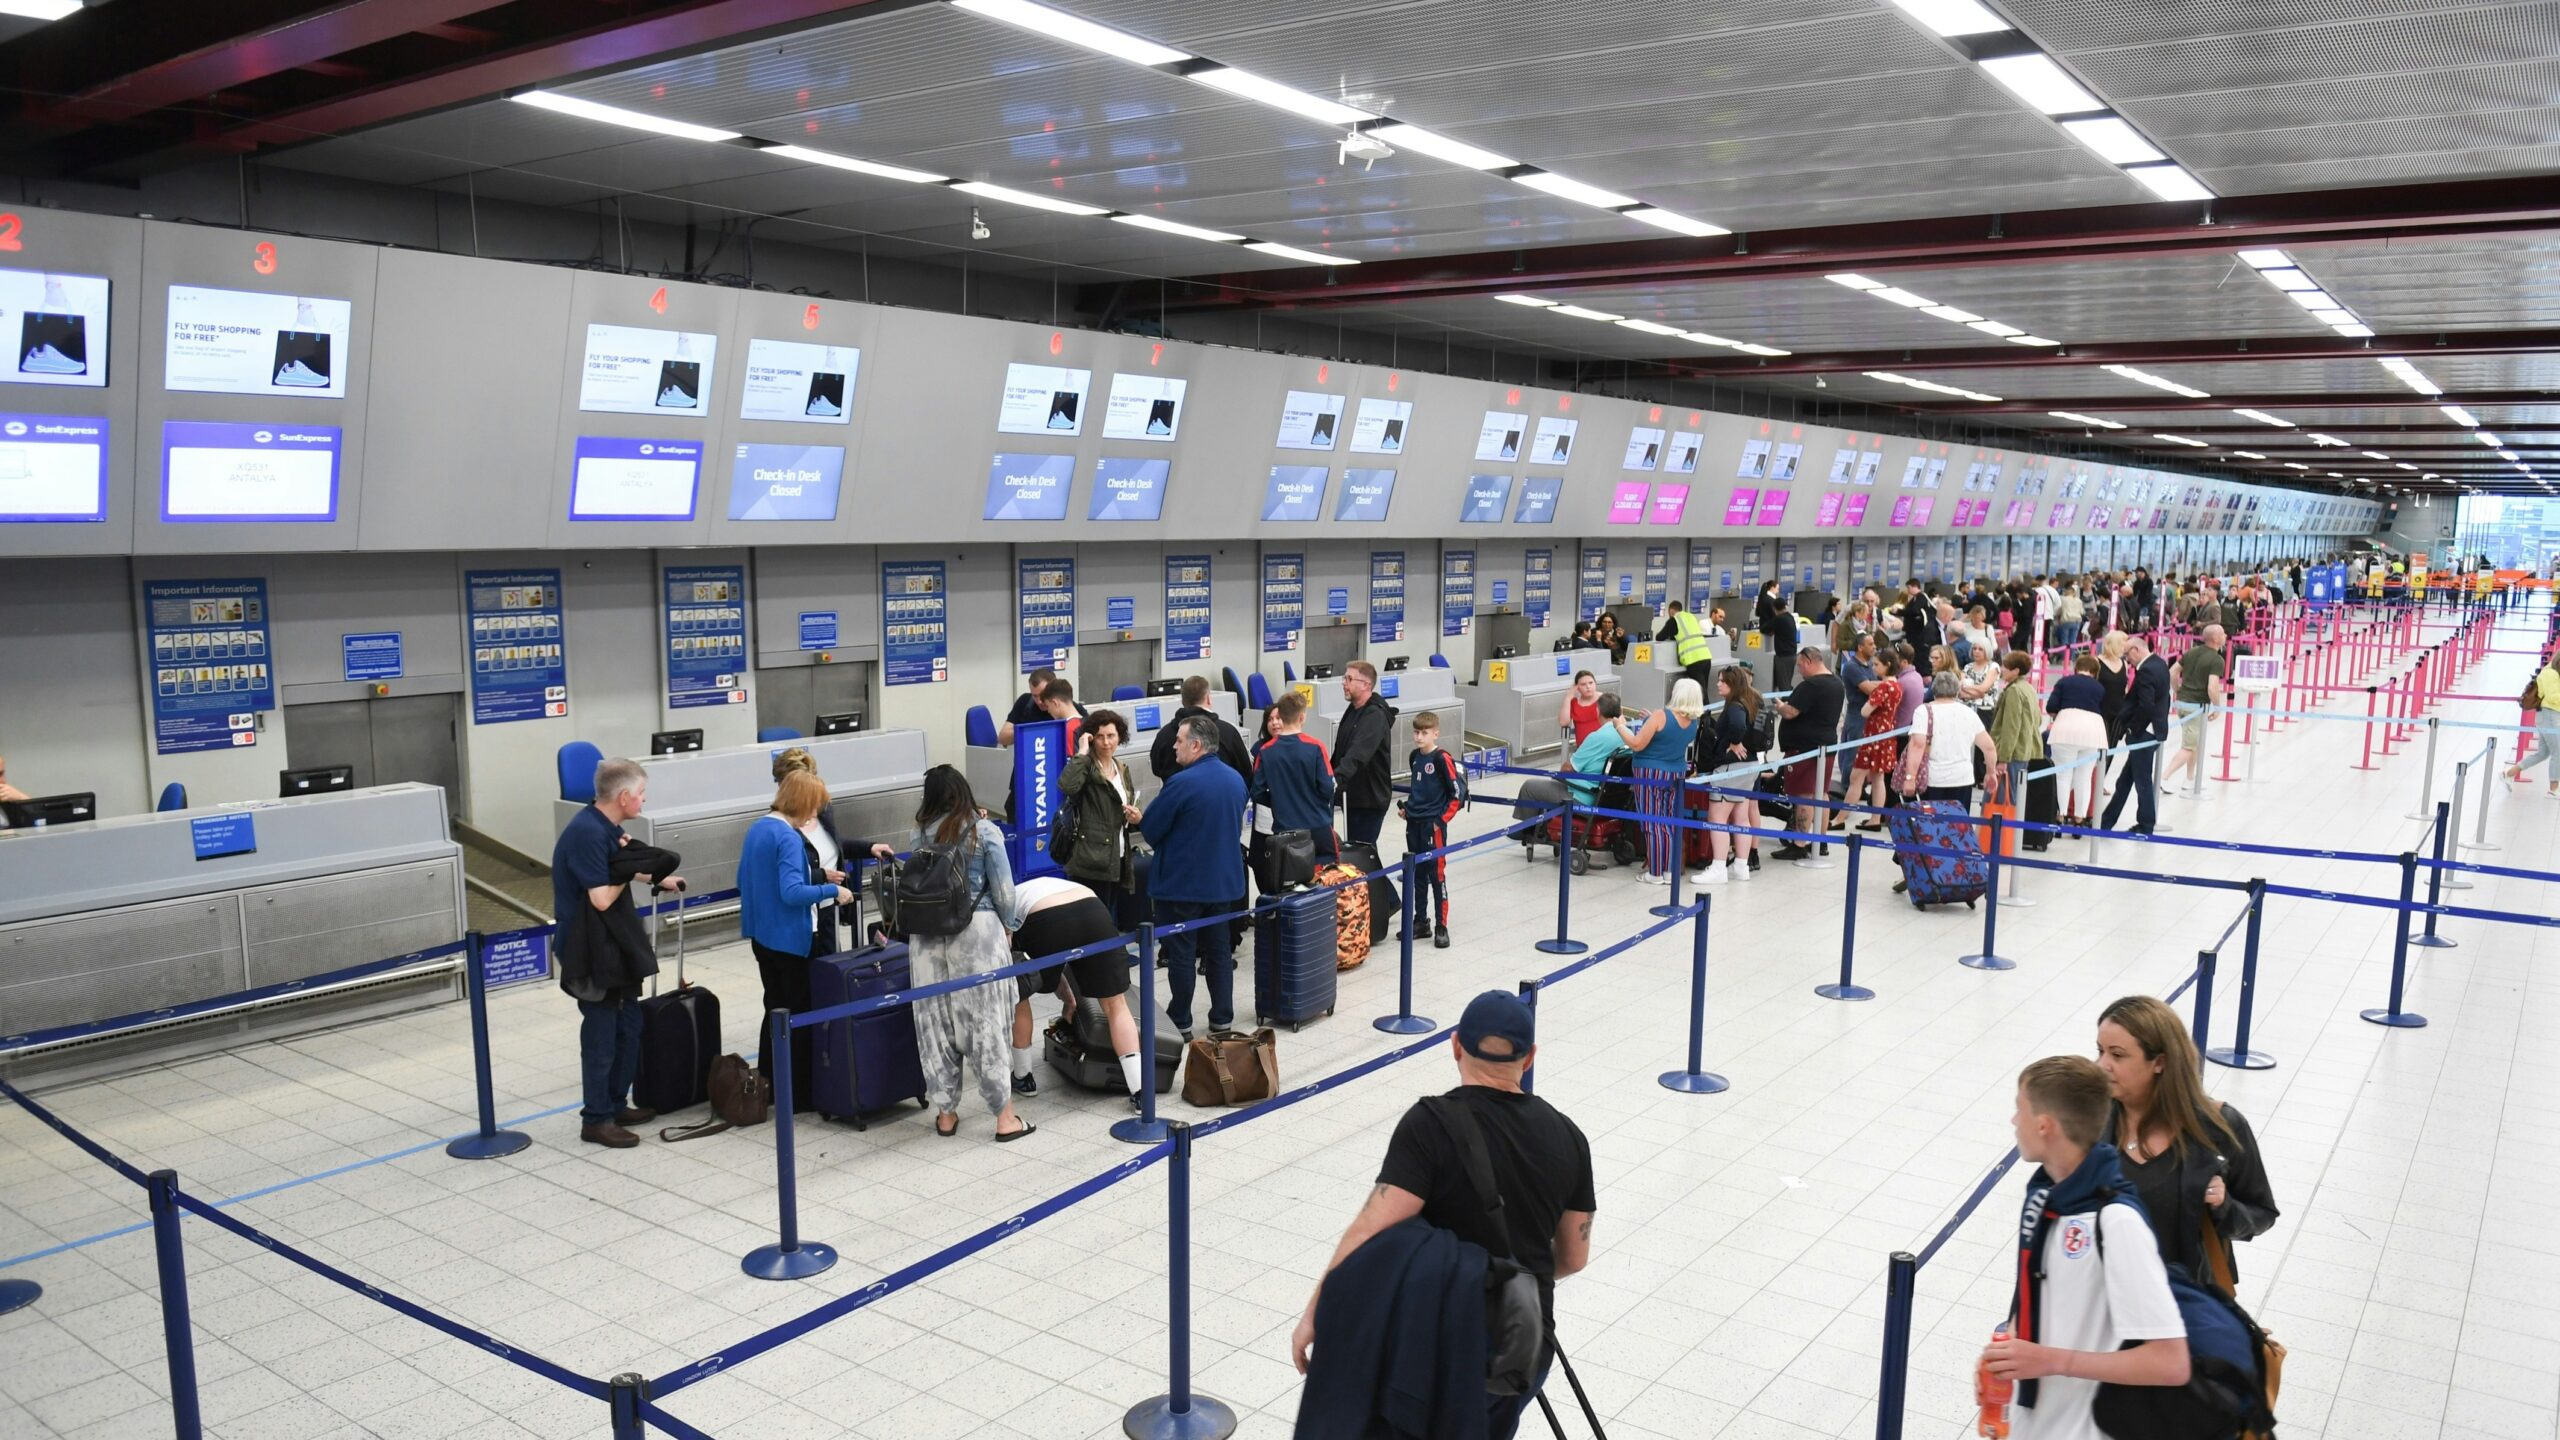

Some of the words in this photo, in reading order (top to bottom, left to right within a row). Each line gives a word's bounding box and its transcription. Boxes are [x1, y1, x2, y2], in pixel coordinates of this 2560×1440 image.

[0, 213, 22, 251] 2
[254, 241, 277, 275] 3
[648, 287, 668, 314] 4
[803, 303, 820, 330] 5
[175, 322, 189, 330] FLY
[192, 324, 216, 332] YOUR
[218, 325, 262, 336] SHOPPING
[174, 332, 192, 340] FOR
[1050, 332, 1063, 355] 6
[1151, 343, 1164, 366] 7
[35, 424, 99, 435] SunExpress
[279, 433, 332, 443] SunExpress
[229, 474, 276, 482] ANTALYA
[753, 469, 796, 482] Check-in
[798, 470, 822, 483] Desk
[1004, 475, 1037, 486] Check-in
[1038, 476, 1056, 487] Desk
[1137, 479, 1153, 489] Desk
[769, 484, 802, 498] Closed
[1016, 488, 1041, 500] Closed
[1116, 490, 1139, 501] Closed
[471, 576, 510, 585] Important
[511, 574, 554, 582] Information
[151, 586, 200, 597] Important
[202, 584, 258, 594] Information
[1035, 736, 1047, 836] RYANAIR
[1702, 822, 1728, 831] Departure
[494, 939, 528, 953] NOTICE
[484, 959, 512, 969] baggage
[522, 954, 538, 962] clear
[491, 953, 512, 961] Please
[513, 949, 531, 957] allow
[490, 968, 510, 976] before
[511, 963, 534, 973] placing
[682, 1372, 702, 1384] LONDON
[702, 1365, 718, 1376] LUTON
